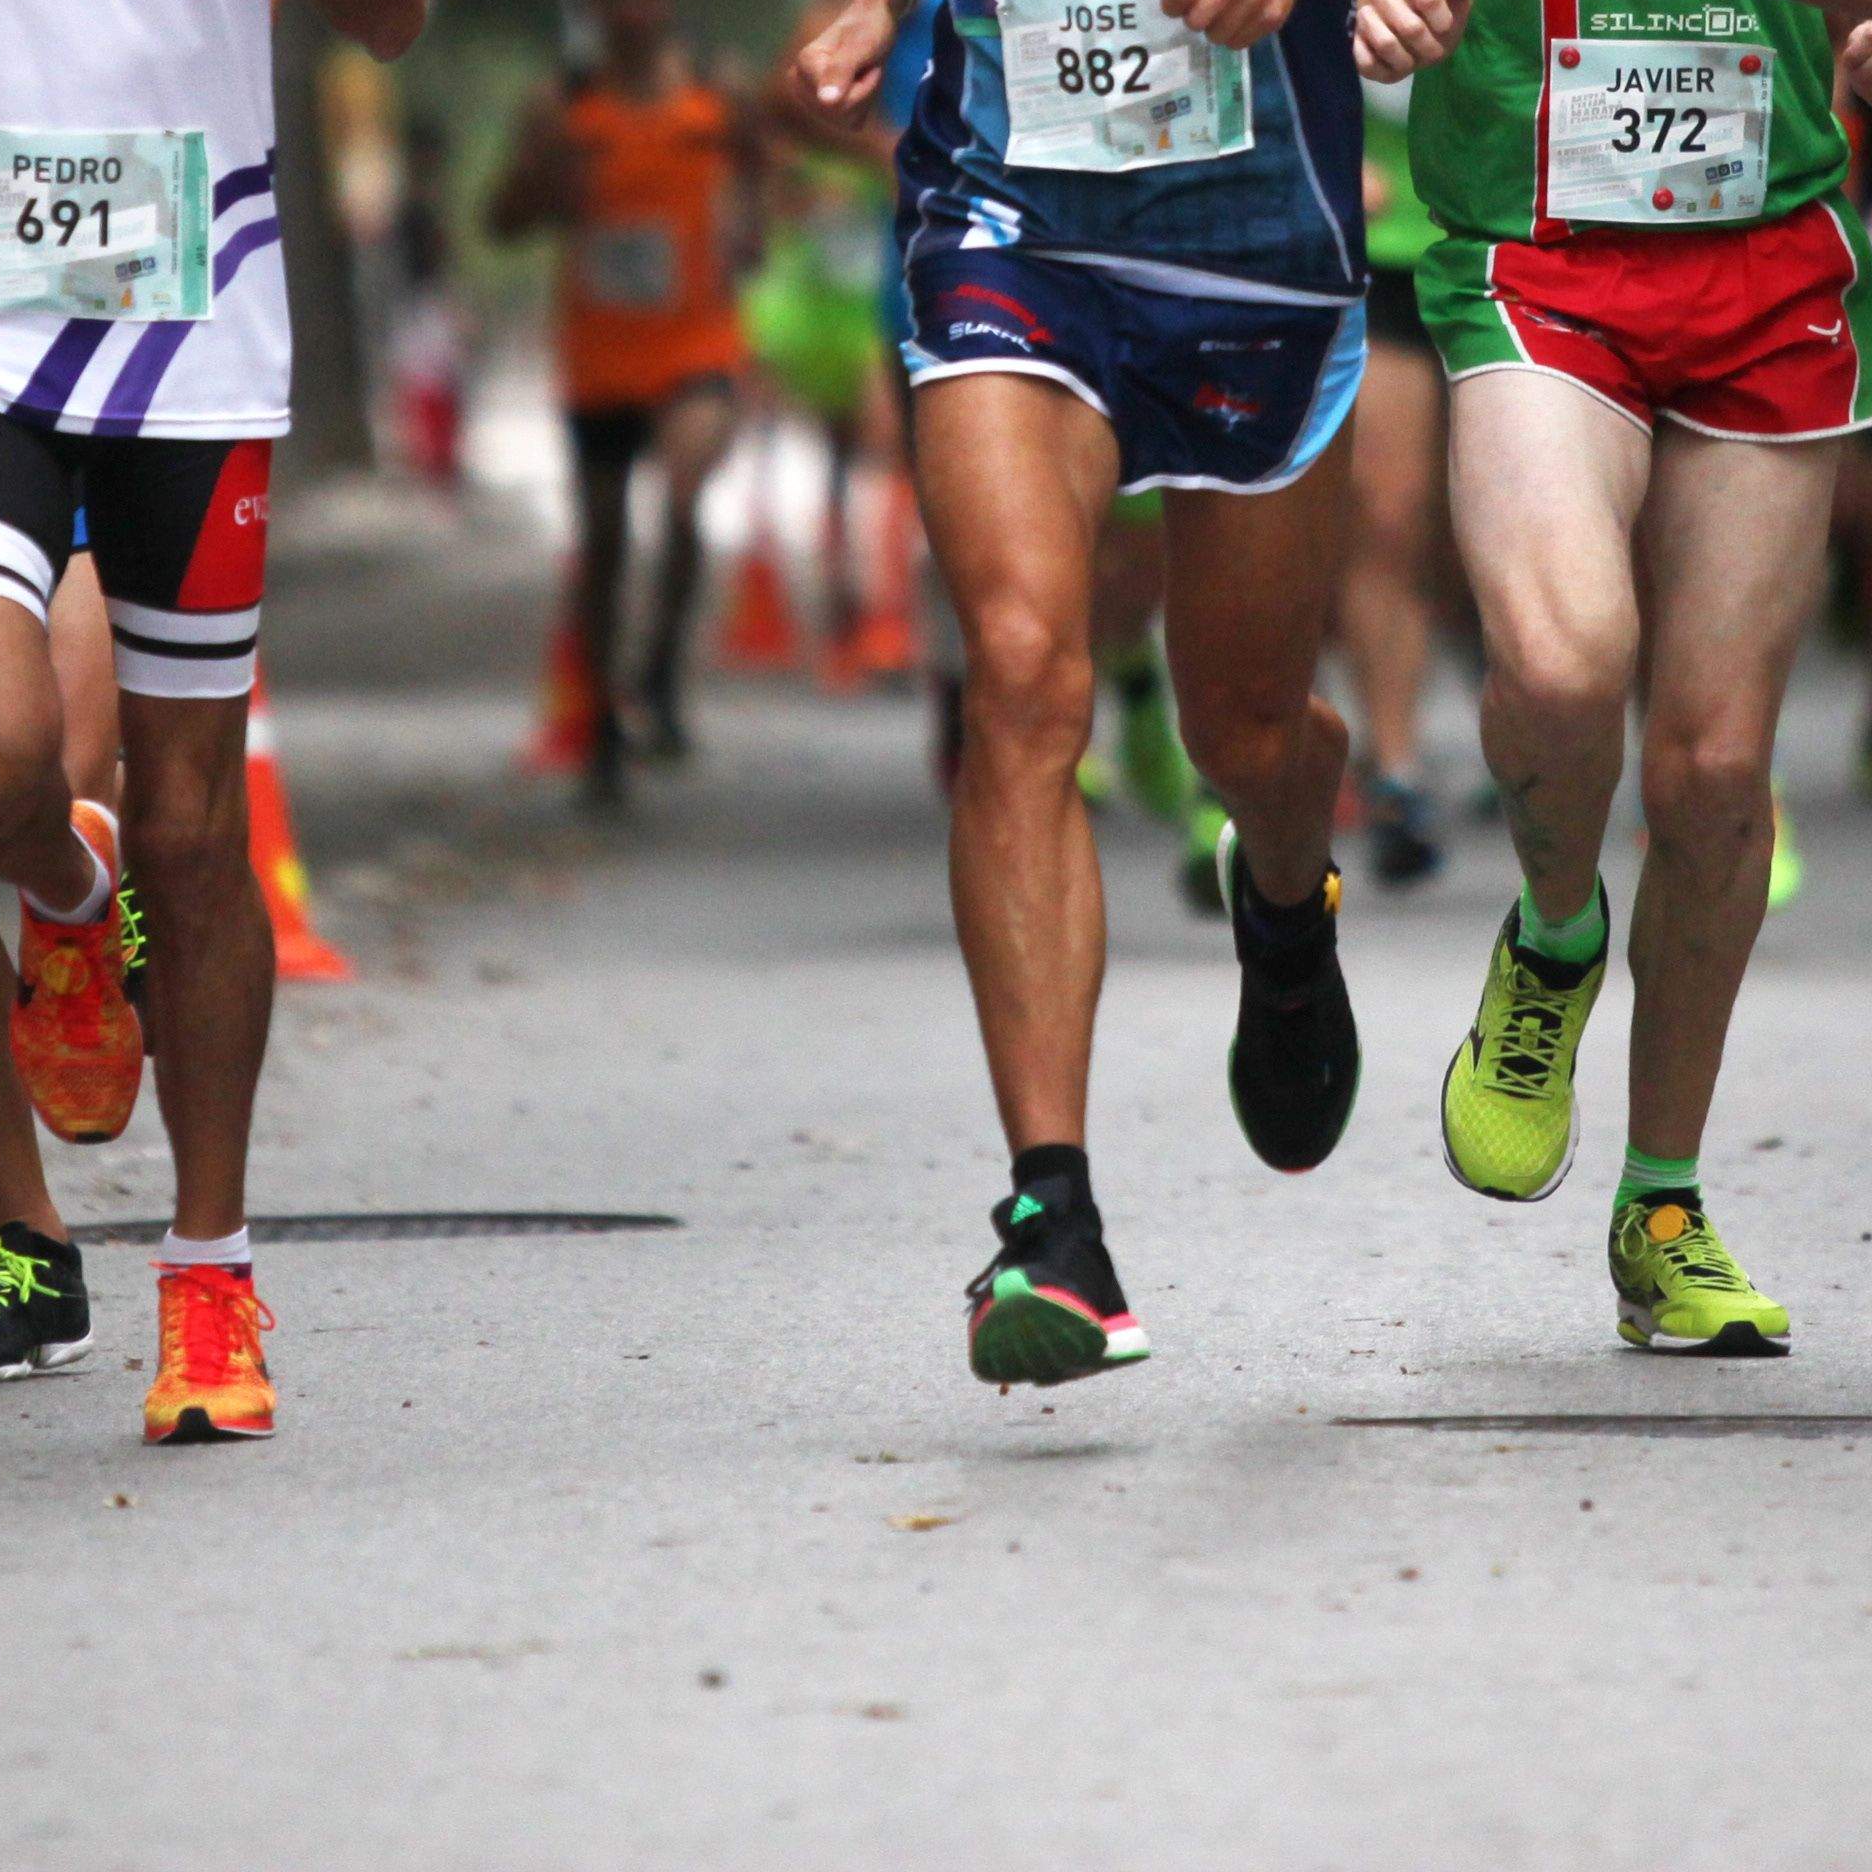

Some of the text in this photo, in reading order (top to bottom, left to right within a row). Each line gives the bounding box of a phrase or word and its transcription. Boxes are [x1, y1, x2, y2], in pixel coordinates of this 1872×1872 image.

[1059, 3, 1137, 33] JOSE
[1056, 45, 1150, 96] 882
[1606, 67, 1715, 94] JAVIER
[1611, 107, 1707, 154] 372
[12, 154, 123, 185] PEDRO
[15, 197, 110, 248] 691
